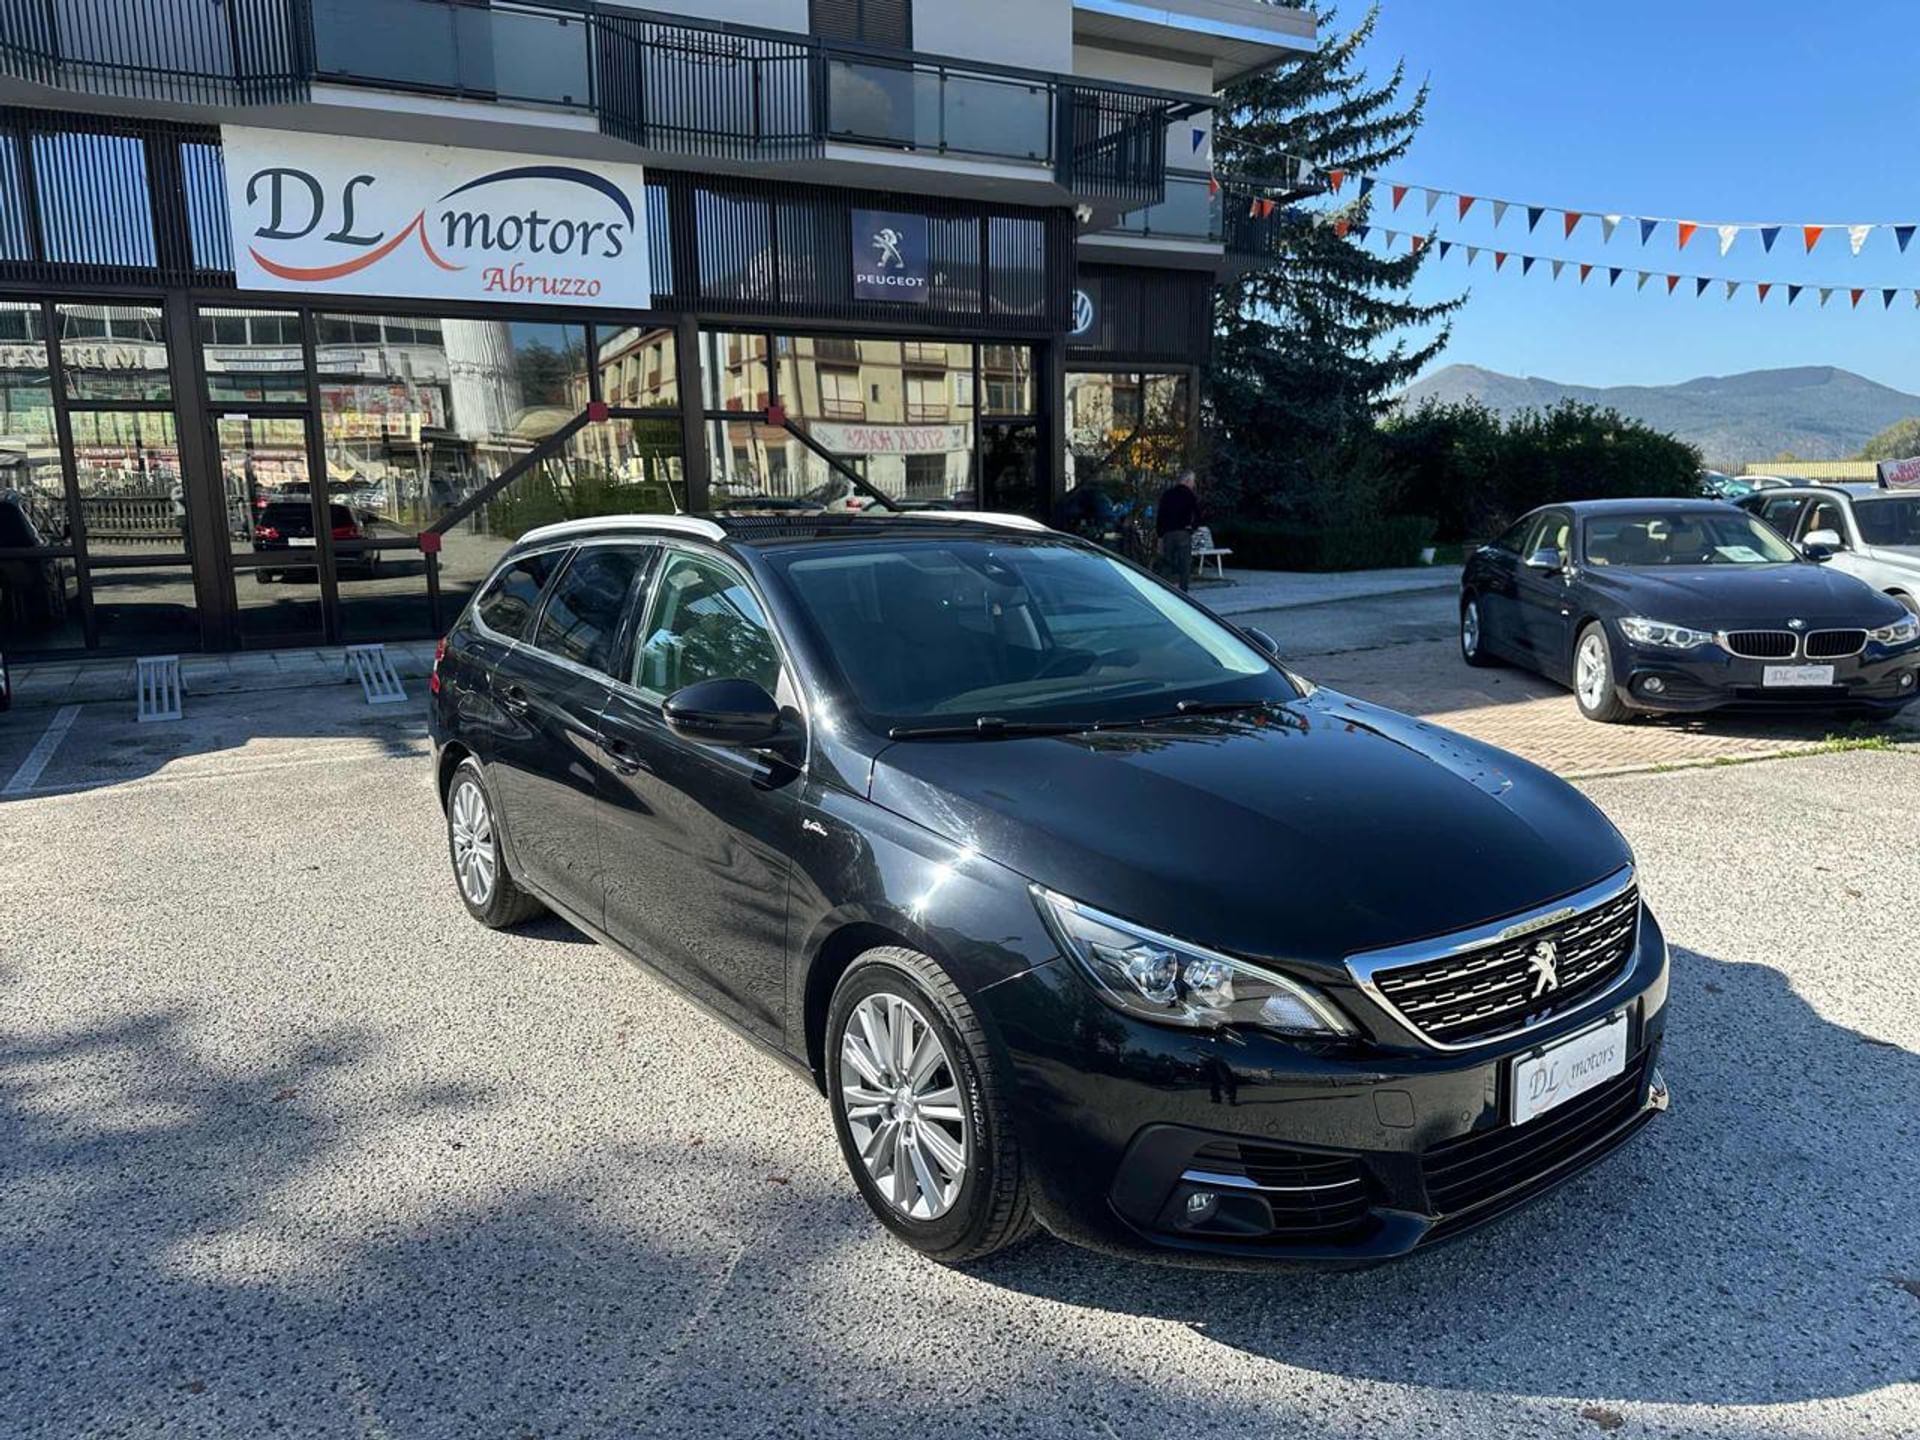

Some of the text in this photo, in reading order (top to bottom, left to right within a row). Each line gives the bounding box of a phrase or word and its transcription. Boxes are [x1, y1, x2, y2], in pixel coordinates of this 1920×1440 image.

[246, 167, 624, 258] DL motors
[482, 262, 601, 297] Abruzzo
[856, 273, 925, 287] PEUGEOT
[1530, 1044, 1615, 1101] DL motors
